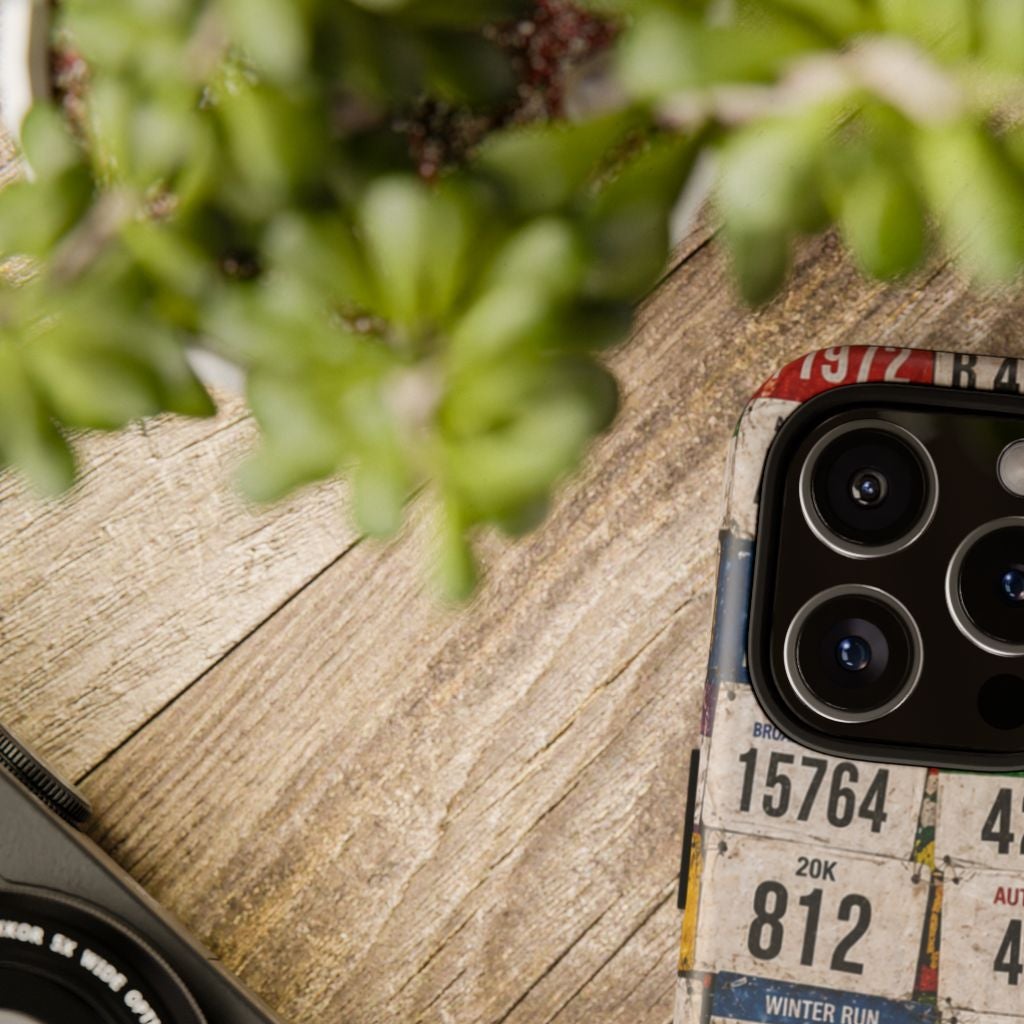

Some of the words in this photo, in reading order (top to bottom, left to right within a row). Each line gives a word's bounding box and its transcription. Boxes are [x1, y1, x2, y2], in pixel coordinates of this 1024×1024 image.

[752, 721, 789, 742] BRO
[738, 747, 890, 834] 15764
[795, 856, 837, 882] 20K
[747, 880, 872, 976] 812
[765, 994, 836, 1024] WINTER
